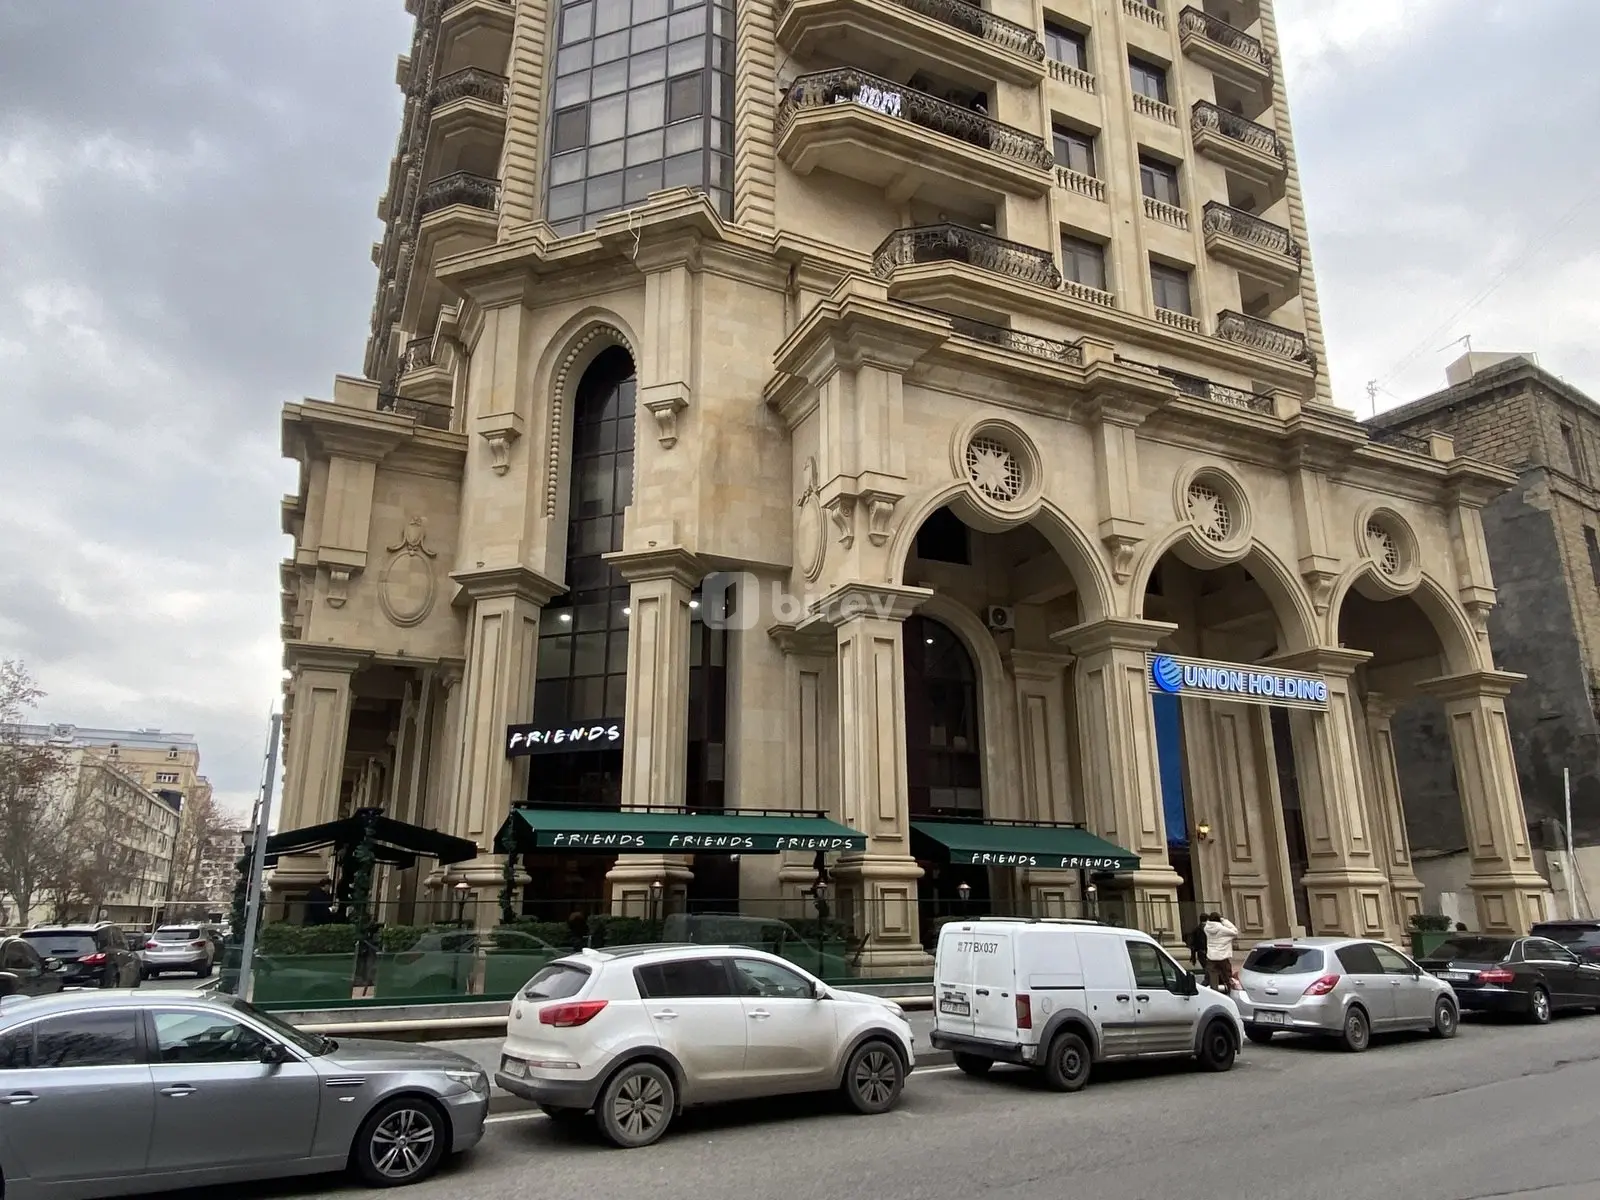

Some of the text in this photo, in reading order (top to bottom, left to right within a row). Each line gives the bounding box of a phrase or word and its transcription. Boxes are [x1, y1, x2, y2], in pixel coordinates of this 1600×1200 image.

[1183, 665, 1327, 702] UNION HOLDING
[776, 837, 853, 850] FRIENDS
[972, 853, 1121, 869] FRIENDS FRIENDS
